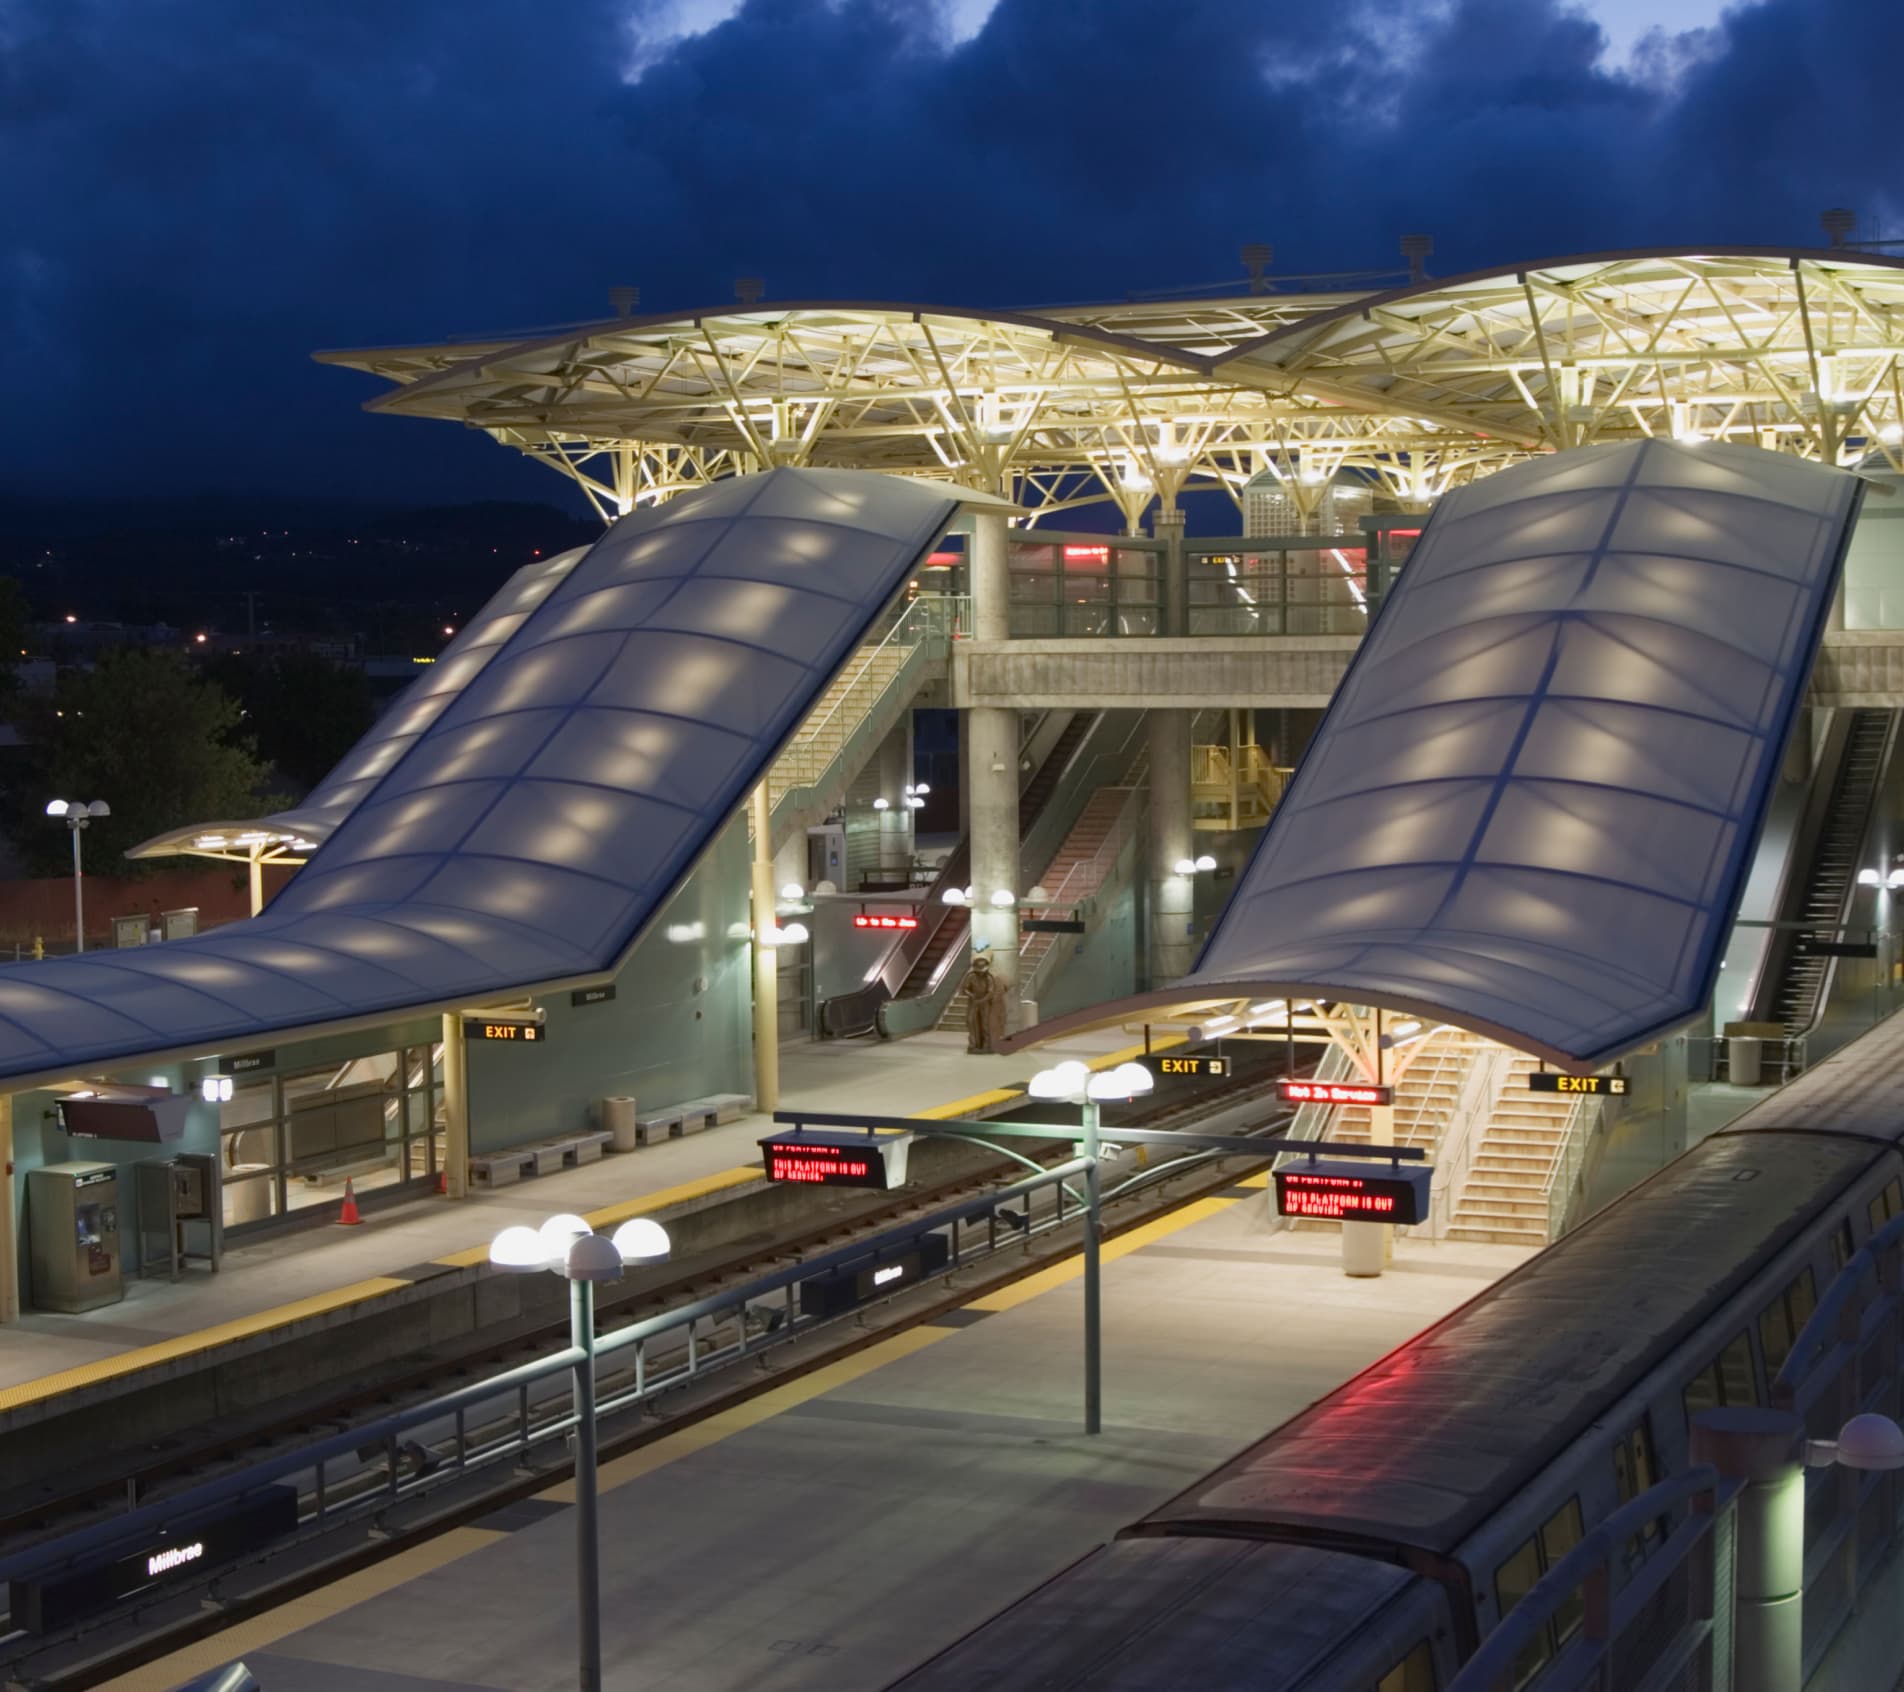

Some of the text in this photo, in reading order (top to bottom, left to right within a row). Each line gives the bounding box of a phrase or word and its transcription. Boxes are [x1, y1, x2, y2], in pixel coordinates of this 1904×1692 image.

[485, 1025, 516, 1039] EXIT
[1161, 1059, 1199, 1073] EXIT
[1557, 1077, 1599, 1092] EXIT
[1288, 1085, 1310, 1097] Not
[1331, 1087, 1377, 1102] Service
[774, 1159, 867, 1176] THIS PLATFORM IS OUT
[1286, 1191, 1393, 1211] THIS PLATFORM IS OUT
[147, 1542, 203, 1576] Millbrae
